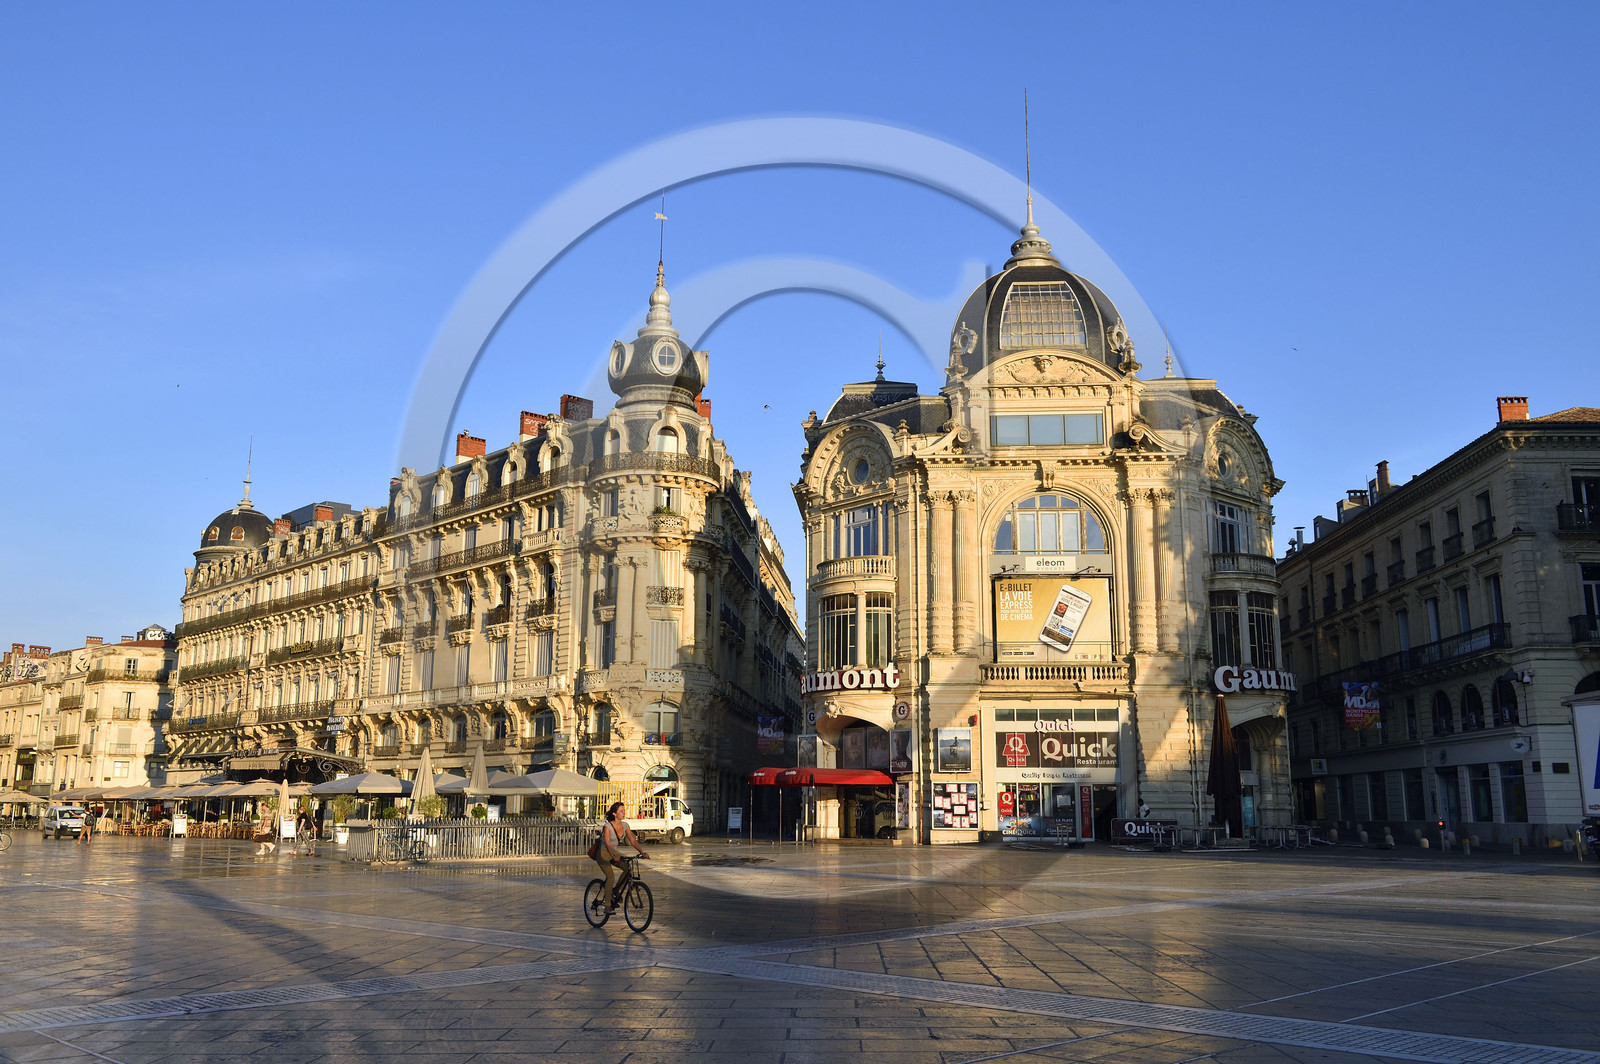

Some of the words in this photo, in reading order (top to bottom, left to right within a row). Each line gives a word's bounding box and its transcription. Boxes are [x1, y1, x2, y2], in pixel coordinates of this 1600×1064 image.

[1036, 557, 1066, 567] eleom
[999, 583, 1033, 592] E-BILLET
[1000, 591, 1010, 601] LA
[1012, 591, 1033, 601] VOIE
[1000, 600, 1034, 610] EXPRESS
[1000, 613, 1009, 621] DE
[1034, 718, 1076, 735] Quick
[1041, 736, 1118, 762] Quick
[1124, 821, 1166, 837] Quick
